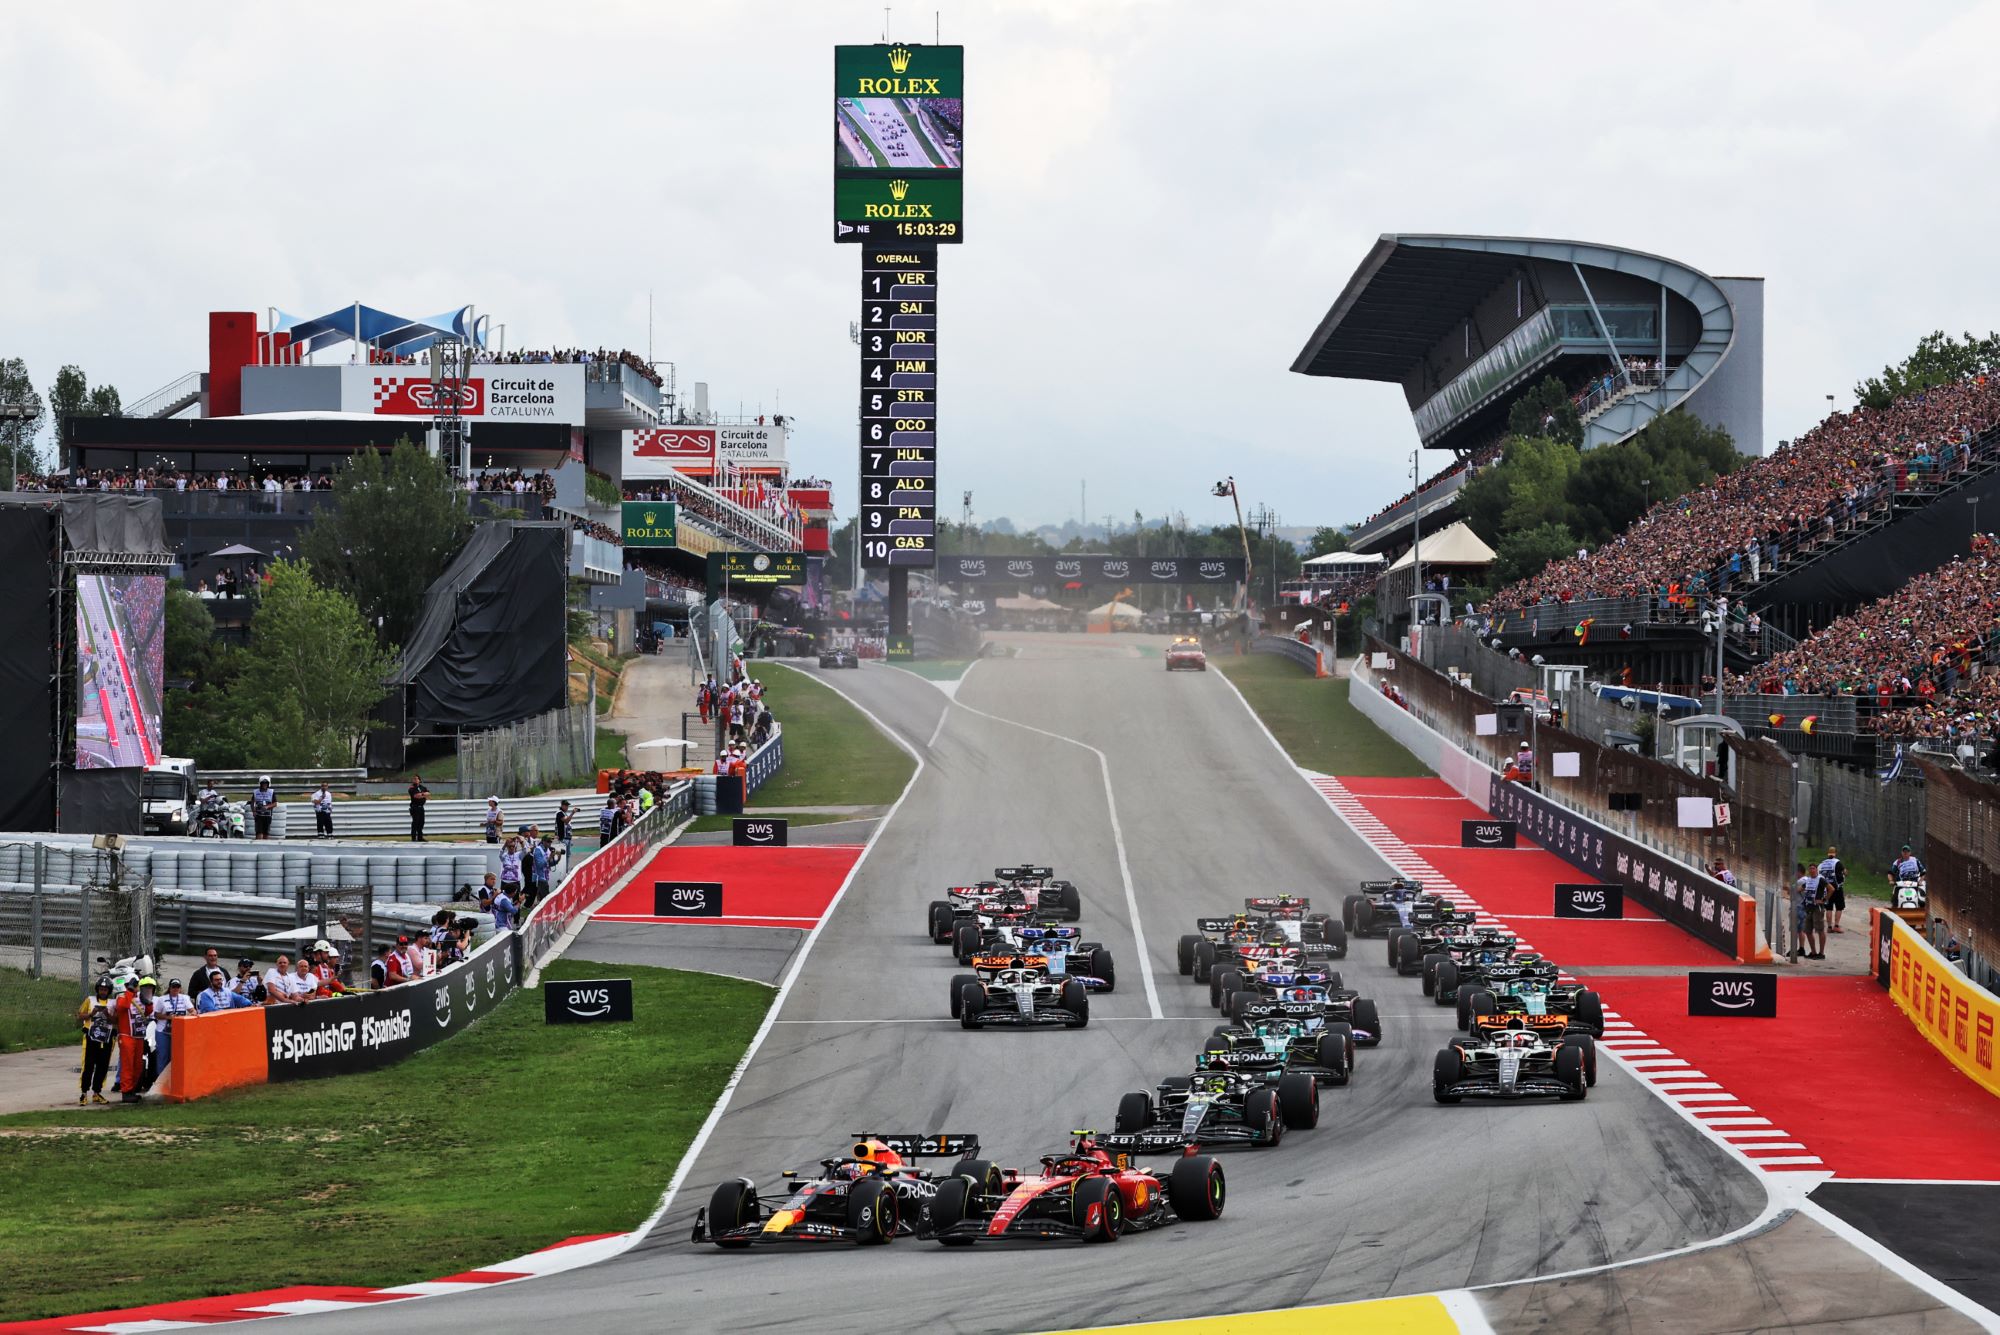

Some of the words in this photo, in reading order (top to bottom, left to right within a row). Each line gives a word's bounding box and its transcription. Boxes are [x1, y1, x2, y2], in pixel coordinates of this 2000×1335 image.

[858, 78, 940, 94] ROLEX
[865, 204, 933, 218] ROLEX
[857, 225, 870, 233] NE
[896, 223, 956, 236] 15:03:29
[876, 254, 920, 264] OVERALL
[872, 278, 881, 293] 1
[897, 273, 925, 284] VER
[871, 307, 882, 322] 2
[900, 302, 922, 314] SAI
[871, 336, 882, 351] 3
[896, 331, 925, 343] NOR
[870, 365, 882, 381] 4
[896, 361, 925, 372] HAM
[491, 378, 534, 390] Circuit
[538, 379, 554, 390] de
[491, 392, 554, 404] Barcelona
[871, 395, 882, 410] 5
[897, 390, 924, 401] STR
[490, 407, 555, 417] CATALUNYA
[721, 430, 754, 439] Circuit
[756, 430, 768, 439] de
[871, 424, 882, 439] 6
[895, 420, 926, 431] OCO
[720, 440, 767, 449] Barcelona
[721, 450, 768, 458] CATALUNYA
[871, 454, 881, 469] 7
[897, 449, 924, 460] HUL
[870, 483, 882, 498] 8
[896, 479, 924, 490] ALO
[870, 512, 881, 527] 9
[899, 508, 921, 519] PIA
[627, 528, 672, 538] ROLEX
[865, 542, 886, 558] 10
[895, 537, 925, 548] GAS
[960, 559, 985, 570] aws
[1007, 560, 1033, 571] aws
[1055, 560, 1081, 571] aws
[1103, 561, 1129, 571] aws
[1151, 561, 1177, 572] aws
[1200, 561, 1225, 572] aws
[747, 823, 773, 834] aws
[1475, 825, 1501, 836] aws
[672, 888, 704, 901] aws
[1572, 890, 1604, 903] aws
[568, 988, 609, 1005] aws
[1712, 981, 1753, 997] aws
[435, 985, 450, 1011] aws
[272, 1021, 356, 1063] #SpanishGP
[361, 1009, 411, 1050] #SpanishGP
